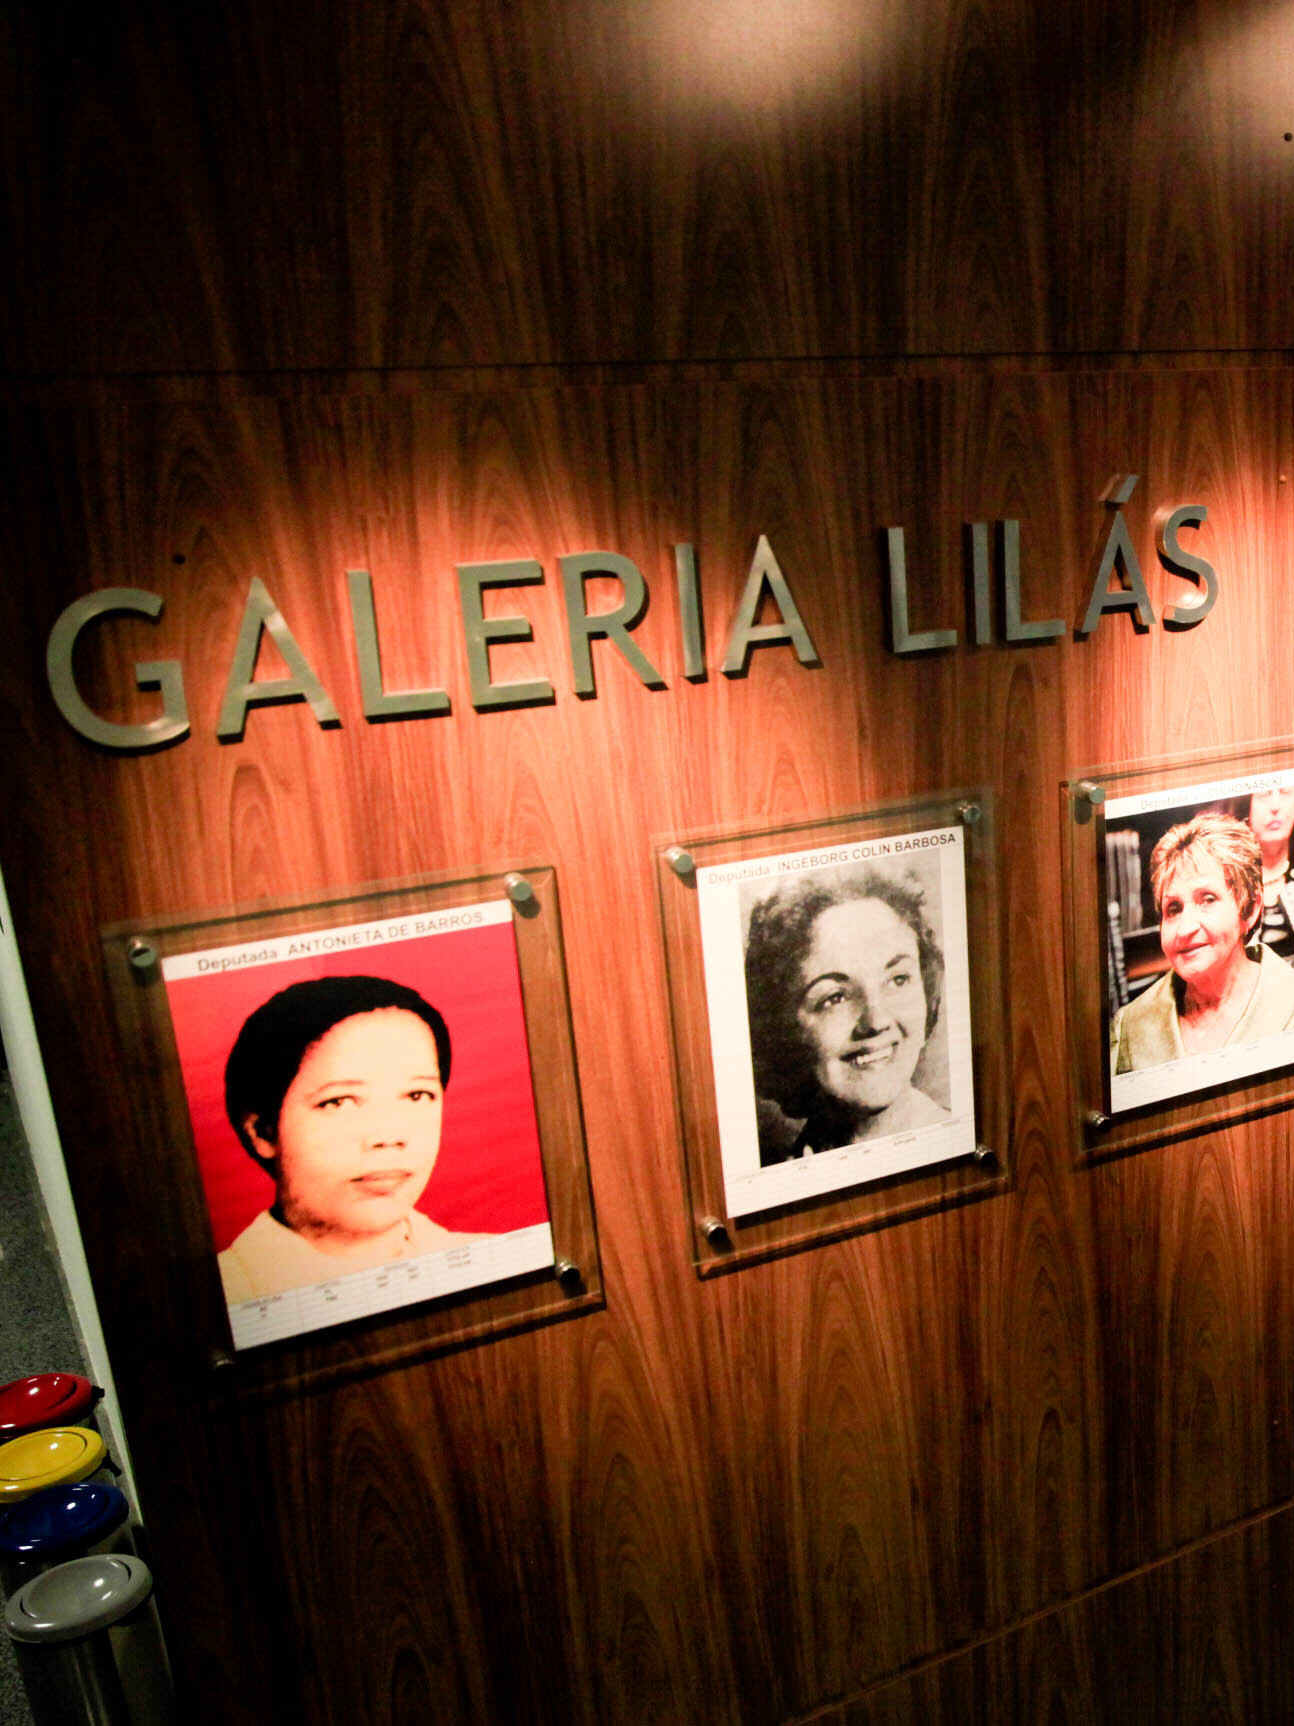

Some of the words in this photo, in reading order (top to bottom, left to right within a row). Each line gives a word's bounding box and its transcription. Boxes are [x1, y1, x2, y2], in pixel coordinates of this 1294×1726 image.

[46, 533, 819, 750] GALERIA
[884, 474, 1218, 654] LILÁS
[708, 866, 771, 886] Deputada
[777, 850, 849, 873] INGEBORG
[851, 843, 892, 860] COLIN
[894, 832, 956, 853] BARBOSA
[197, 948, 278, 973] Deputada
[288, 929, 384, 956] ANTONIETA
[388, 924, 409, 939] DE
[415, 911, 484, 935] BARROS
